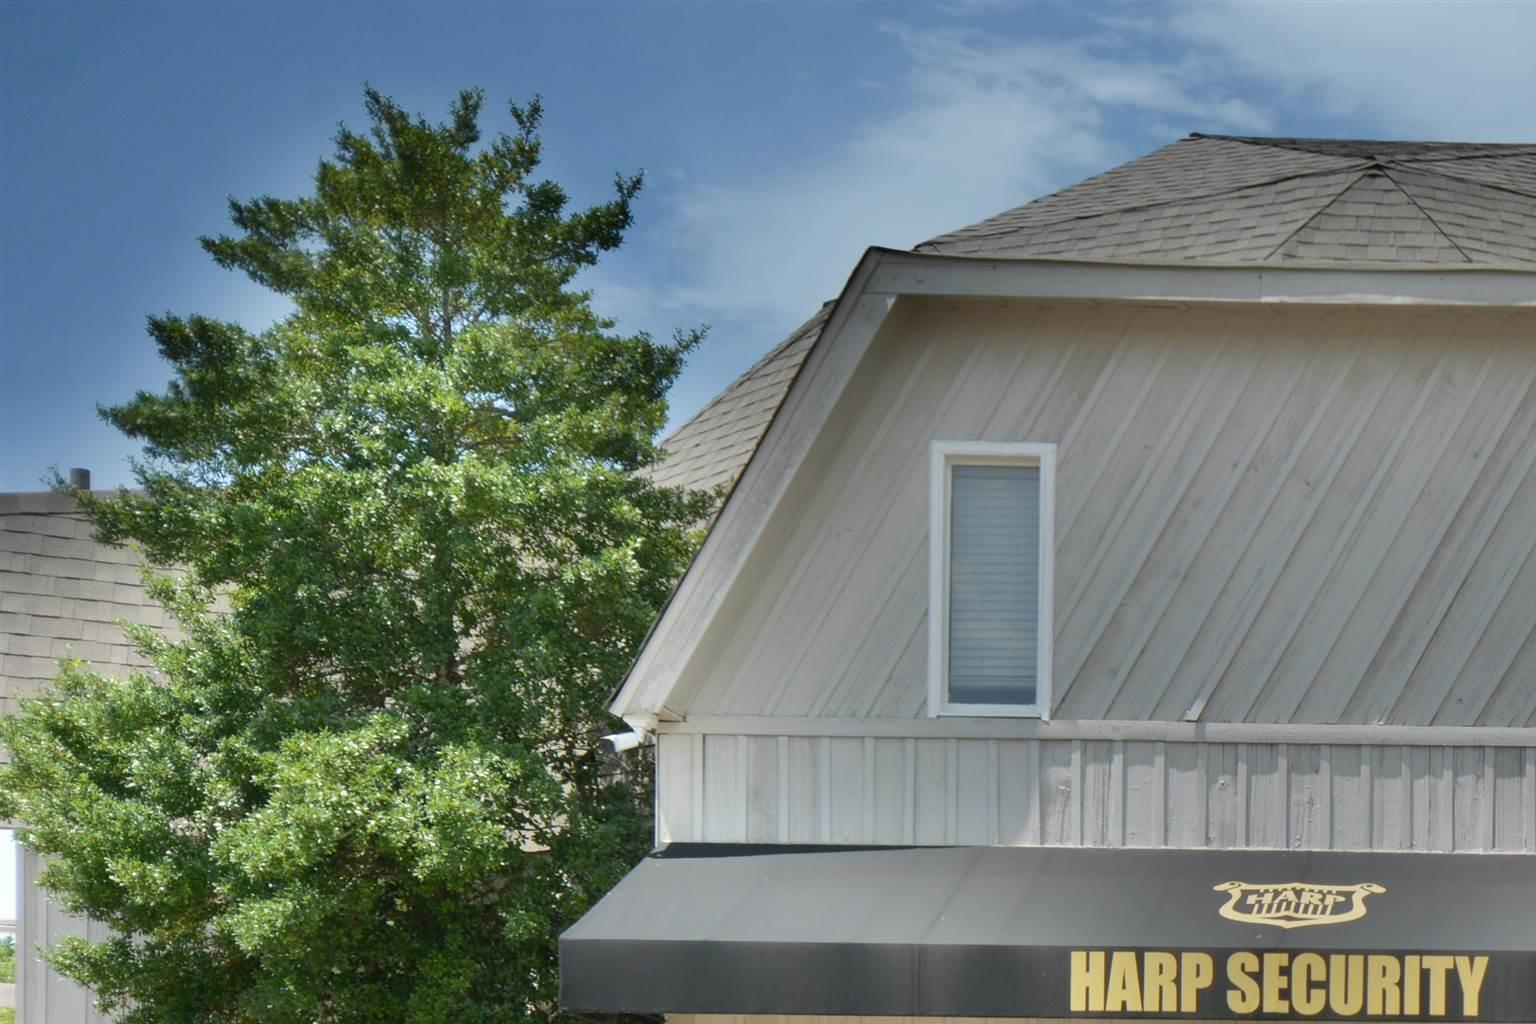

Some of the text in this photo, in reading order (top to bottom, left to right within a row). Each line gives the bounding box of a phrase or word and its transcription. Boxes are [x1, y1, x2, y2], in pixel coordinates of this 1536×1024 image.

[1246, 890, 1346, 905] HARP
[1070, 951, 1489, 1017] HARP SECURITY
